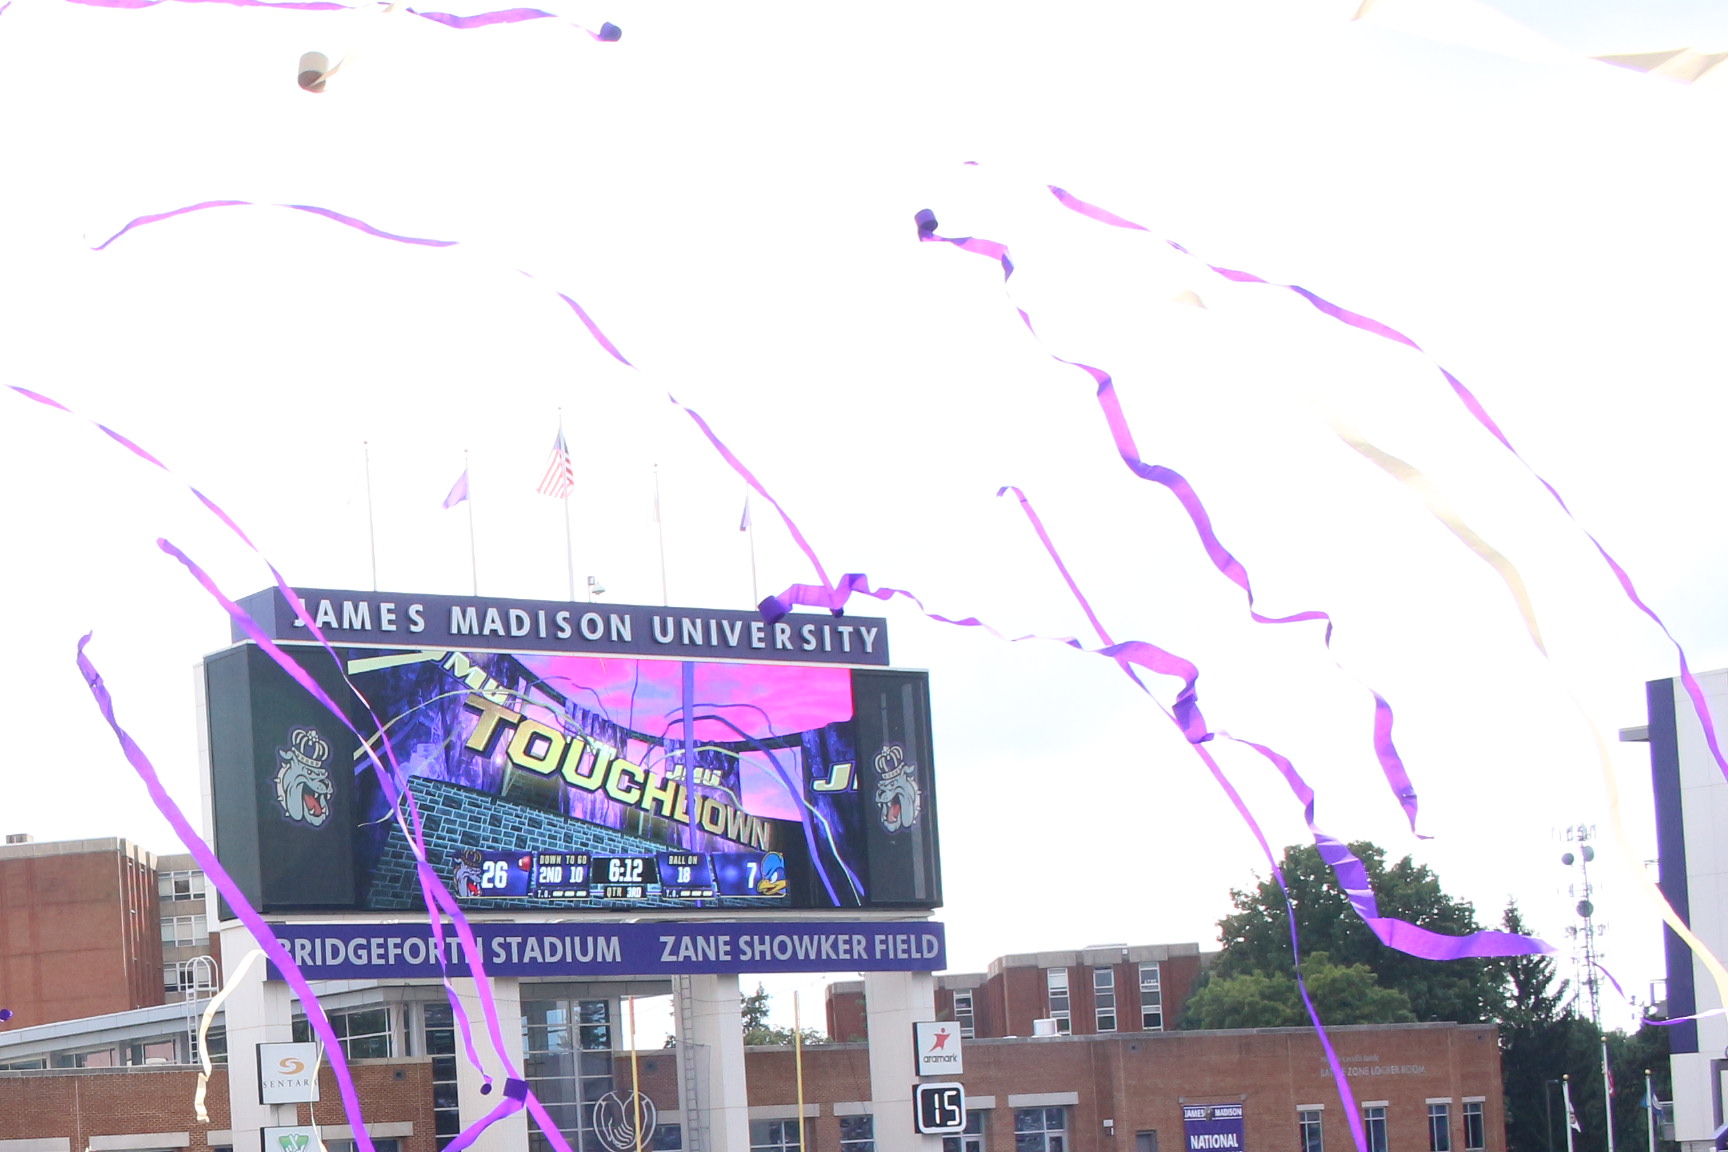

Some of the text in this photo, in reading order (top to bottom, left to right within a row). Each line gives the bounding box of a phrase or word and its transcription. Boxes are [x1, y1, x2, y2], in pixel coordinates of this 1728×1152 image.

[293, 598, 879, 654] JAMES MADISON UNIVERSITY
[461, 694, 771, 850] TOUCHDOWN
[538, 854, 588, 866] DOWN TO GO
[668, 855, 698, 866] BALL ON
[482, 860, 508, 888] 26
[538, 866, 584, 883] 2ND 10
[608, 858, 643, 882] 6:12
[677, 866, 691, 884] 18
[746, 861, 758, 889] 7
[605, 886, 642, 898] QTR 3RD
[491, 936, 622, 964] STADIUM
[659, 935, 732, 962] ZANE
[739, 934, 868, 961] SHOWKER
[874, 933, 940, 960] FIELD
[923, 1053, 958, 1064] aramark
[933, 1090, 961, 1126] 15
[1184, 1107, 1243, 1118] JAMES MADISON
[1190, 1133, 1239, 1149] NATIONAL
